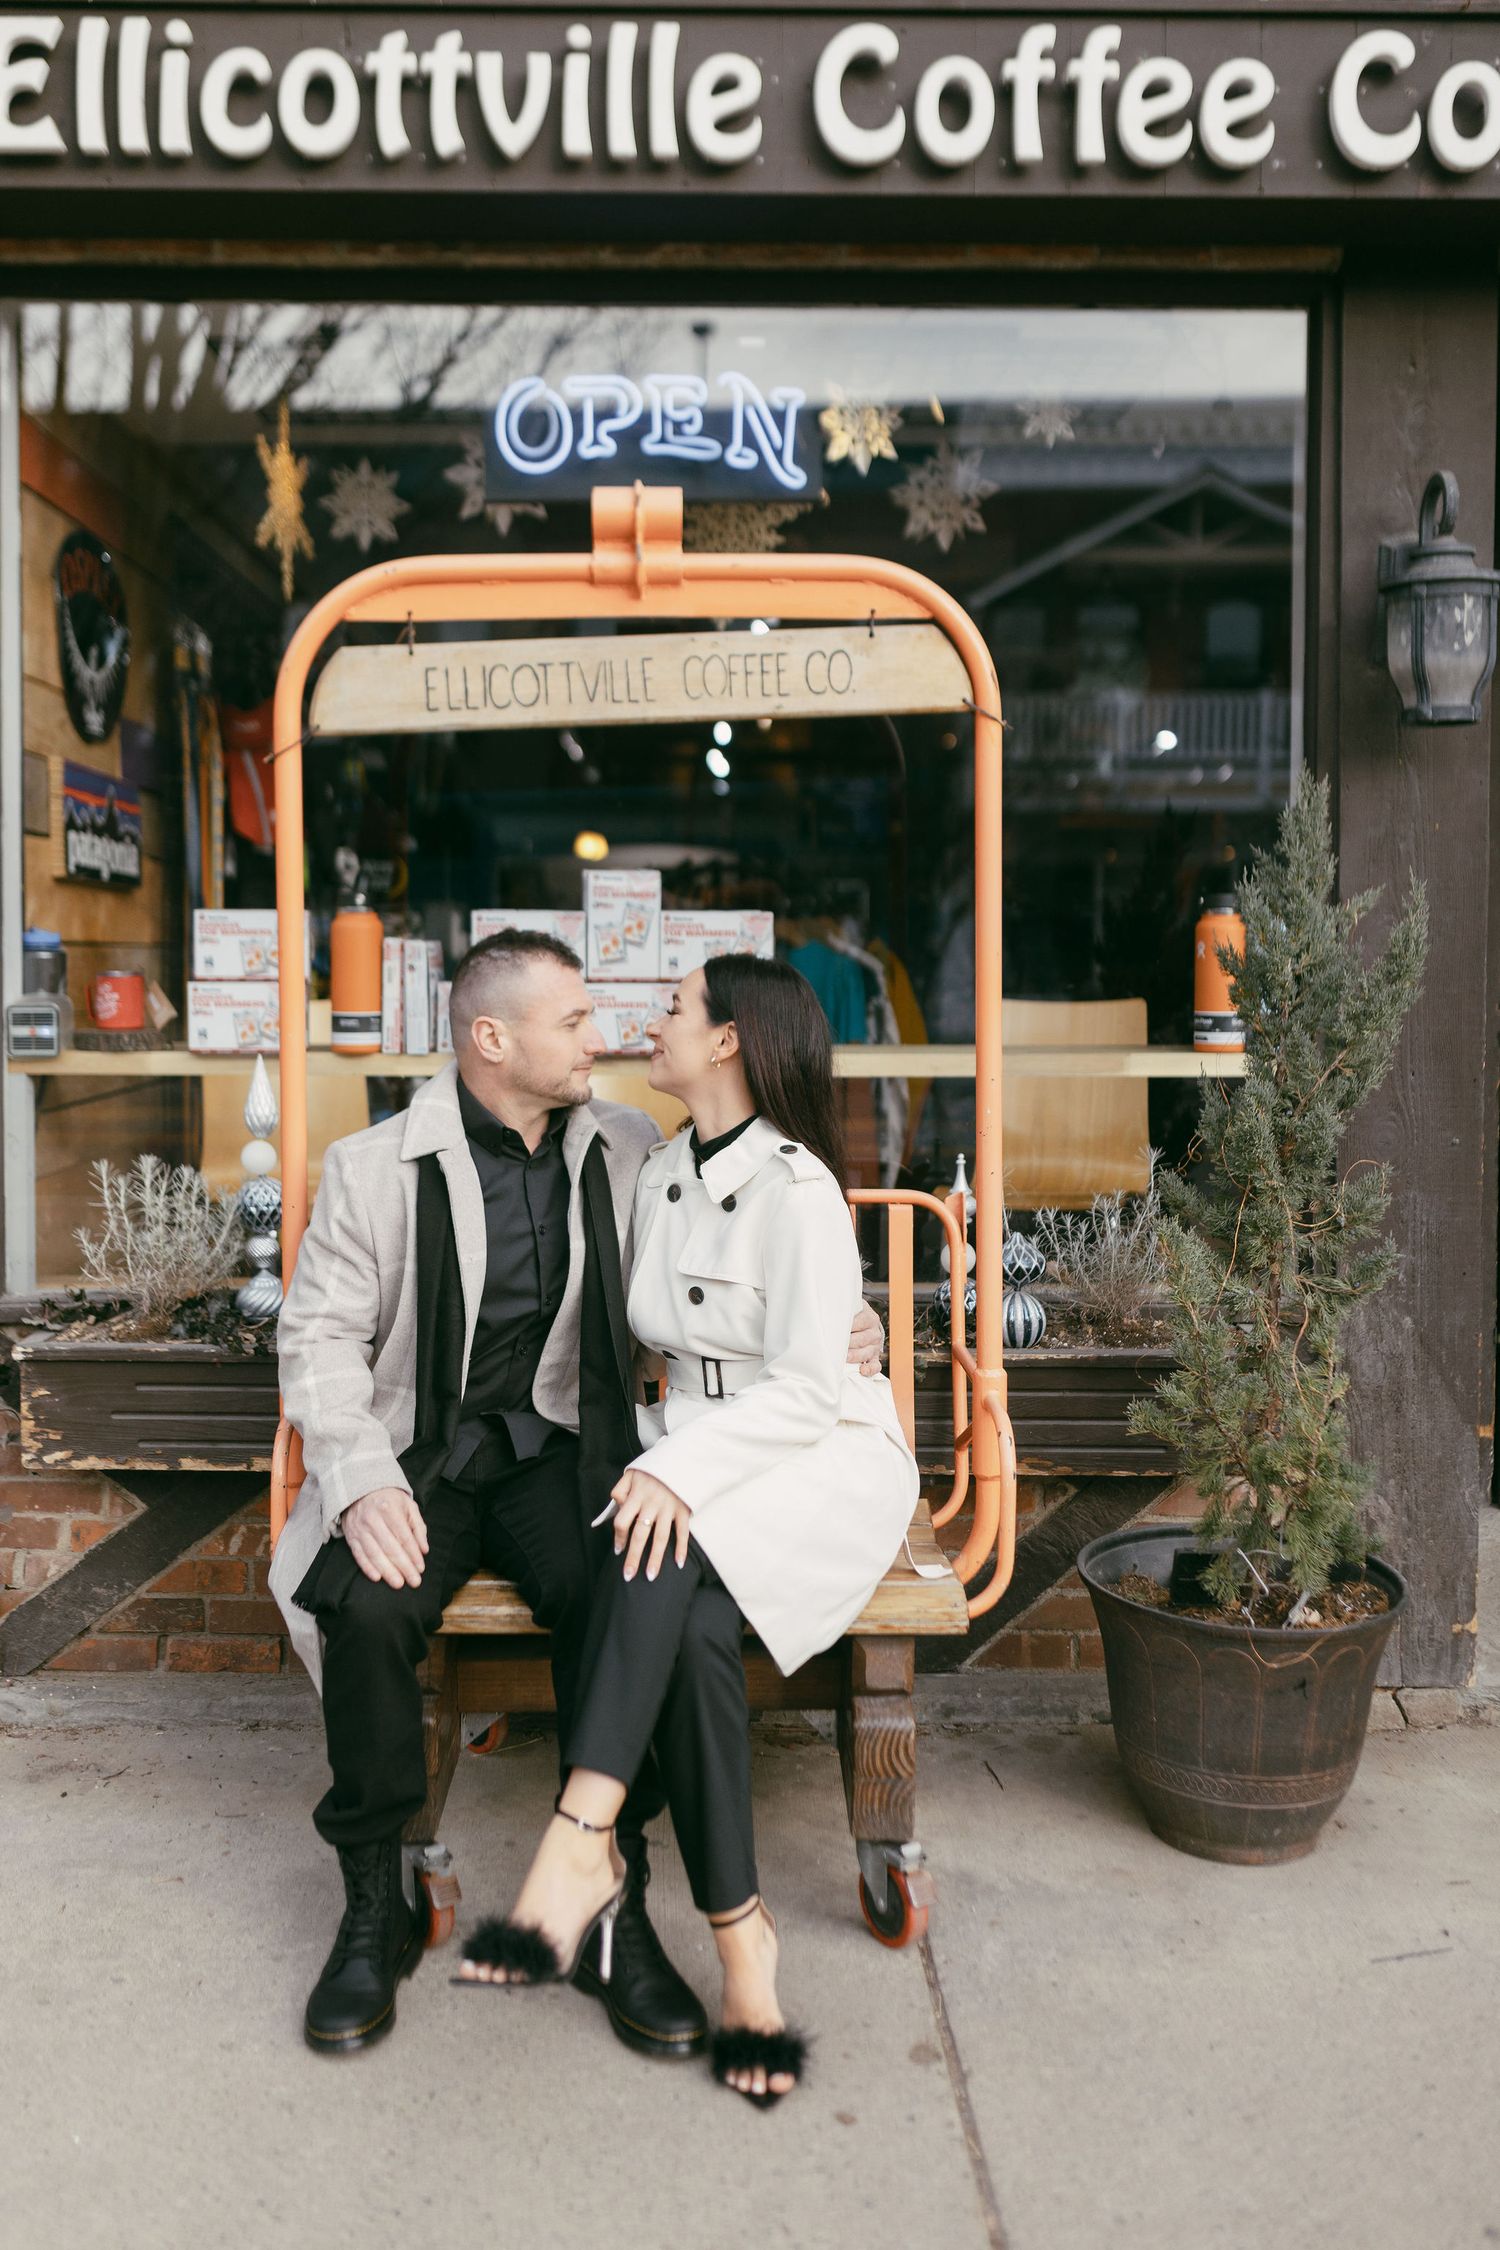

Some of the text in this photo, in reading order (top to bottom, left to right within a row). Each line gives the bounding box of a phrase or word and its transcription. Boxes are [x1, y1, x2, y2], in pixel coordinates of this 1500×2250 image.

[0, 16, 1500, 173] Ellicottville Coffee Co
[494, 371, 808, 490] OPEN
[424, 649, 857, 712] ELLICOTTVILLE COFFEE CO.
[67, 829, 140, 882] patagonia
